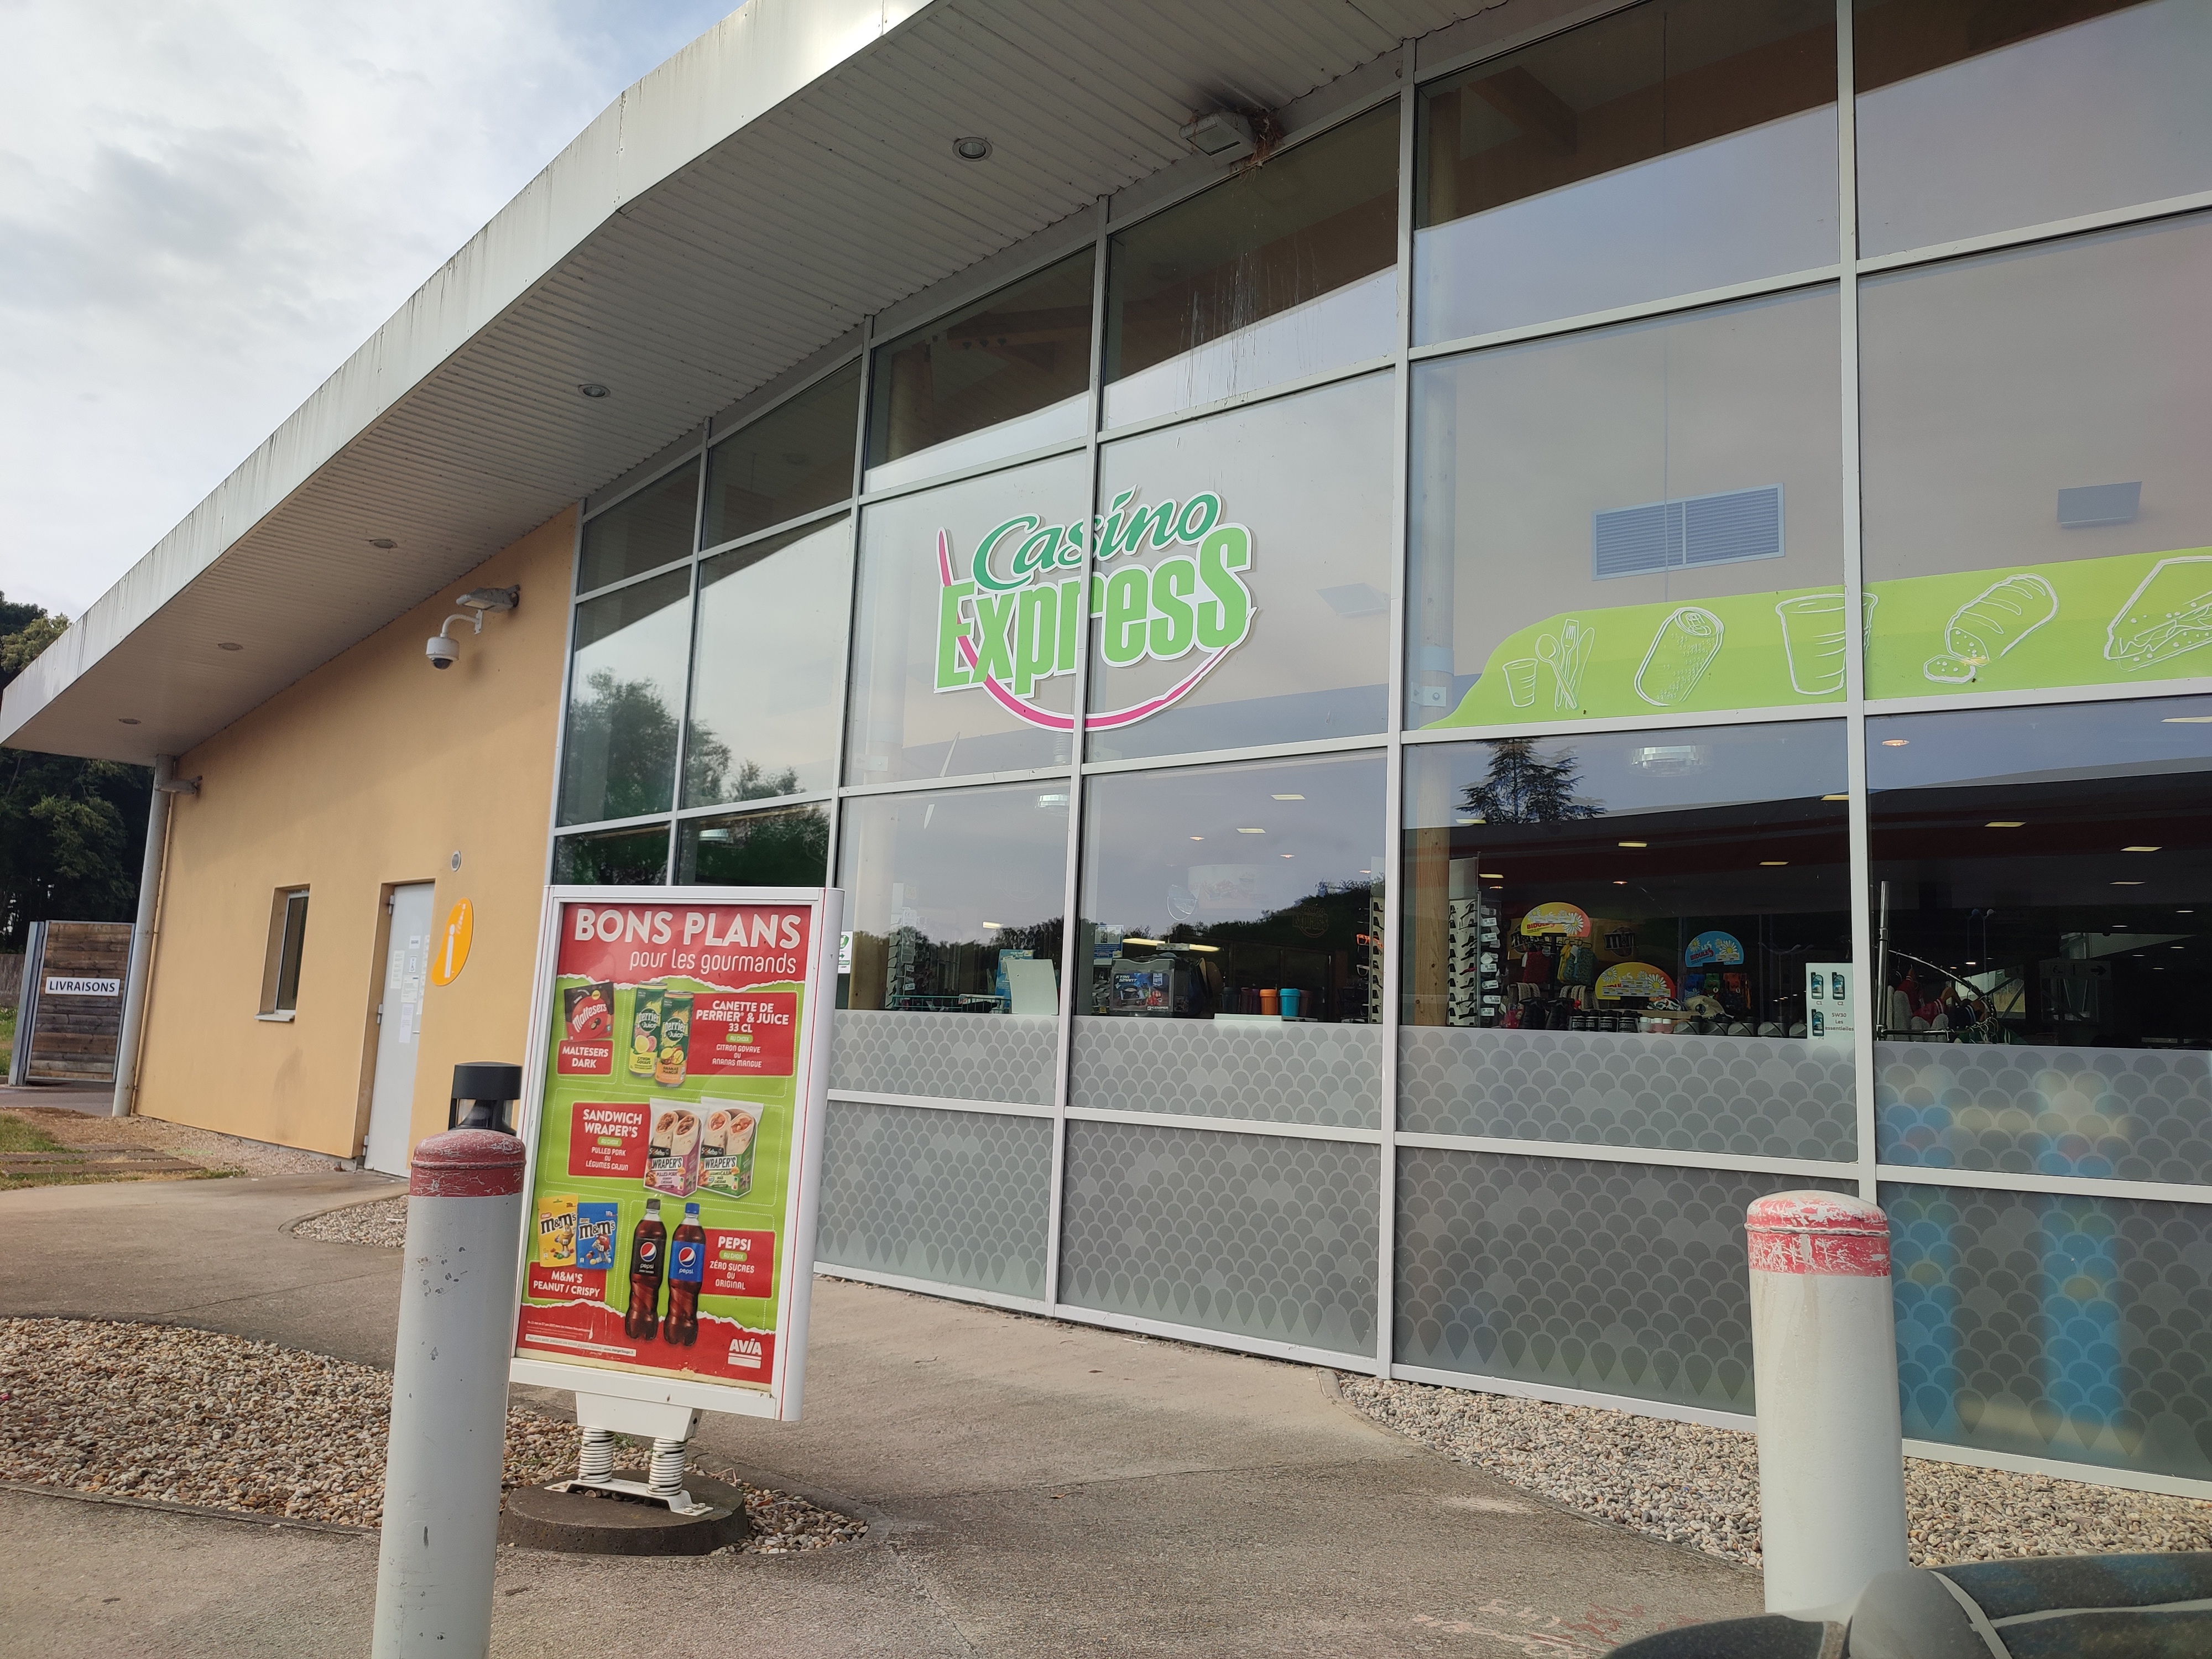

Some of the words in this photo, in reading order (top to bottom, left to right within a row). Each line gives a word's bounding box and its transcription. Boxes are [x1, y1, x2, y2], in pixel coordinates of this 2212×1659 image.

[973, 489, 1220, 591] Casino
[575, 908, 674, 945] BONS
[683, 912, 801, 949] PLANS
[629, 951, 667, 971] pour
[671, 948, 696, 969] les
[700, 952, 796, 974] gourmands
[49, 980, 116, 993] LIVRAISONS
[712, 1000, 758, 1012] CANETTE
[759, 1003, 774, 1013] DE
[572, 1004, 607, 1033] Maltesers
[747, 1012, 754, 1023] &
[756, 1013, 790, 1025] JUICE
[728, 1022, 739, 1032] 33
[741, 1024, 753, 1033] CL
[562, 1046, 609, 1057] MALTESERS
[716, 1044, 737, 1052] CITRON
[738, 1045, 761, 1053] GOYAVE
[572, 1058, 597, 1068] DARK
[712, 1058, 735, 1066] ANANAS
[737, 1060, 762, 1068] MANGUE
[583, 1108, 642, 1125] SANDWICH
[585, 1121, 638, 1138] WRAPER'S
[591, 1146, 611, 1155] PULLED
[585, 1160, 610, 1169] LÉGUMES
[611, 1162, 629, 1171] CAJUN
[653, 1157, 682, 1169] WRAPER'S
[705, 1157, 736, 1168] WRAPER'S
[718, 1235, 752, 1251] PEPSI
[709, 1260, 727, 1270] ZÉRO
[728, 1263, 755, 1274] SUCRES
[551, 1270, 583, 1284] M&M'S
[533, 1280, 565, 1293] PEANUT
[571, 1285, 601, 1297] CRISPY
[715, 1279, 746, 1290] ORIGINAL
